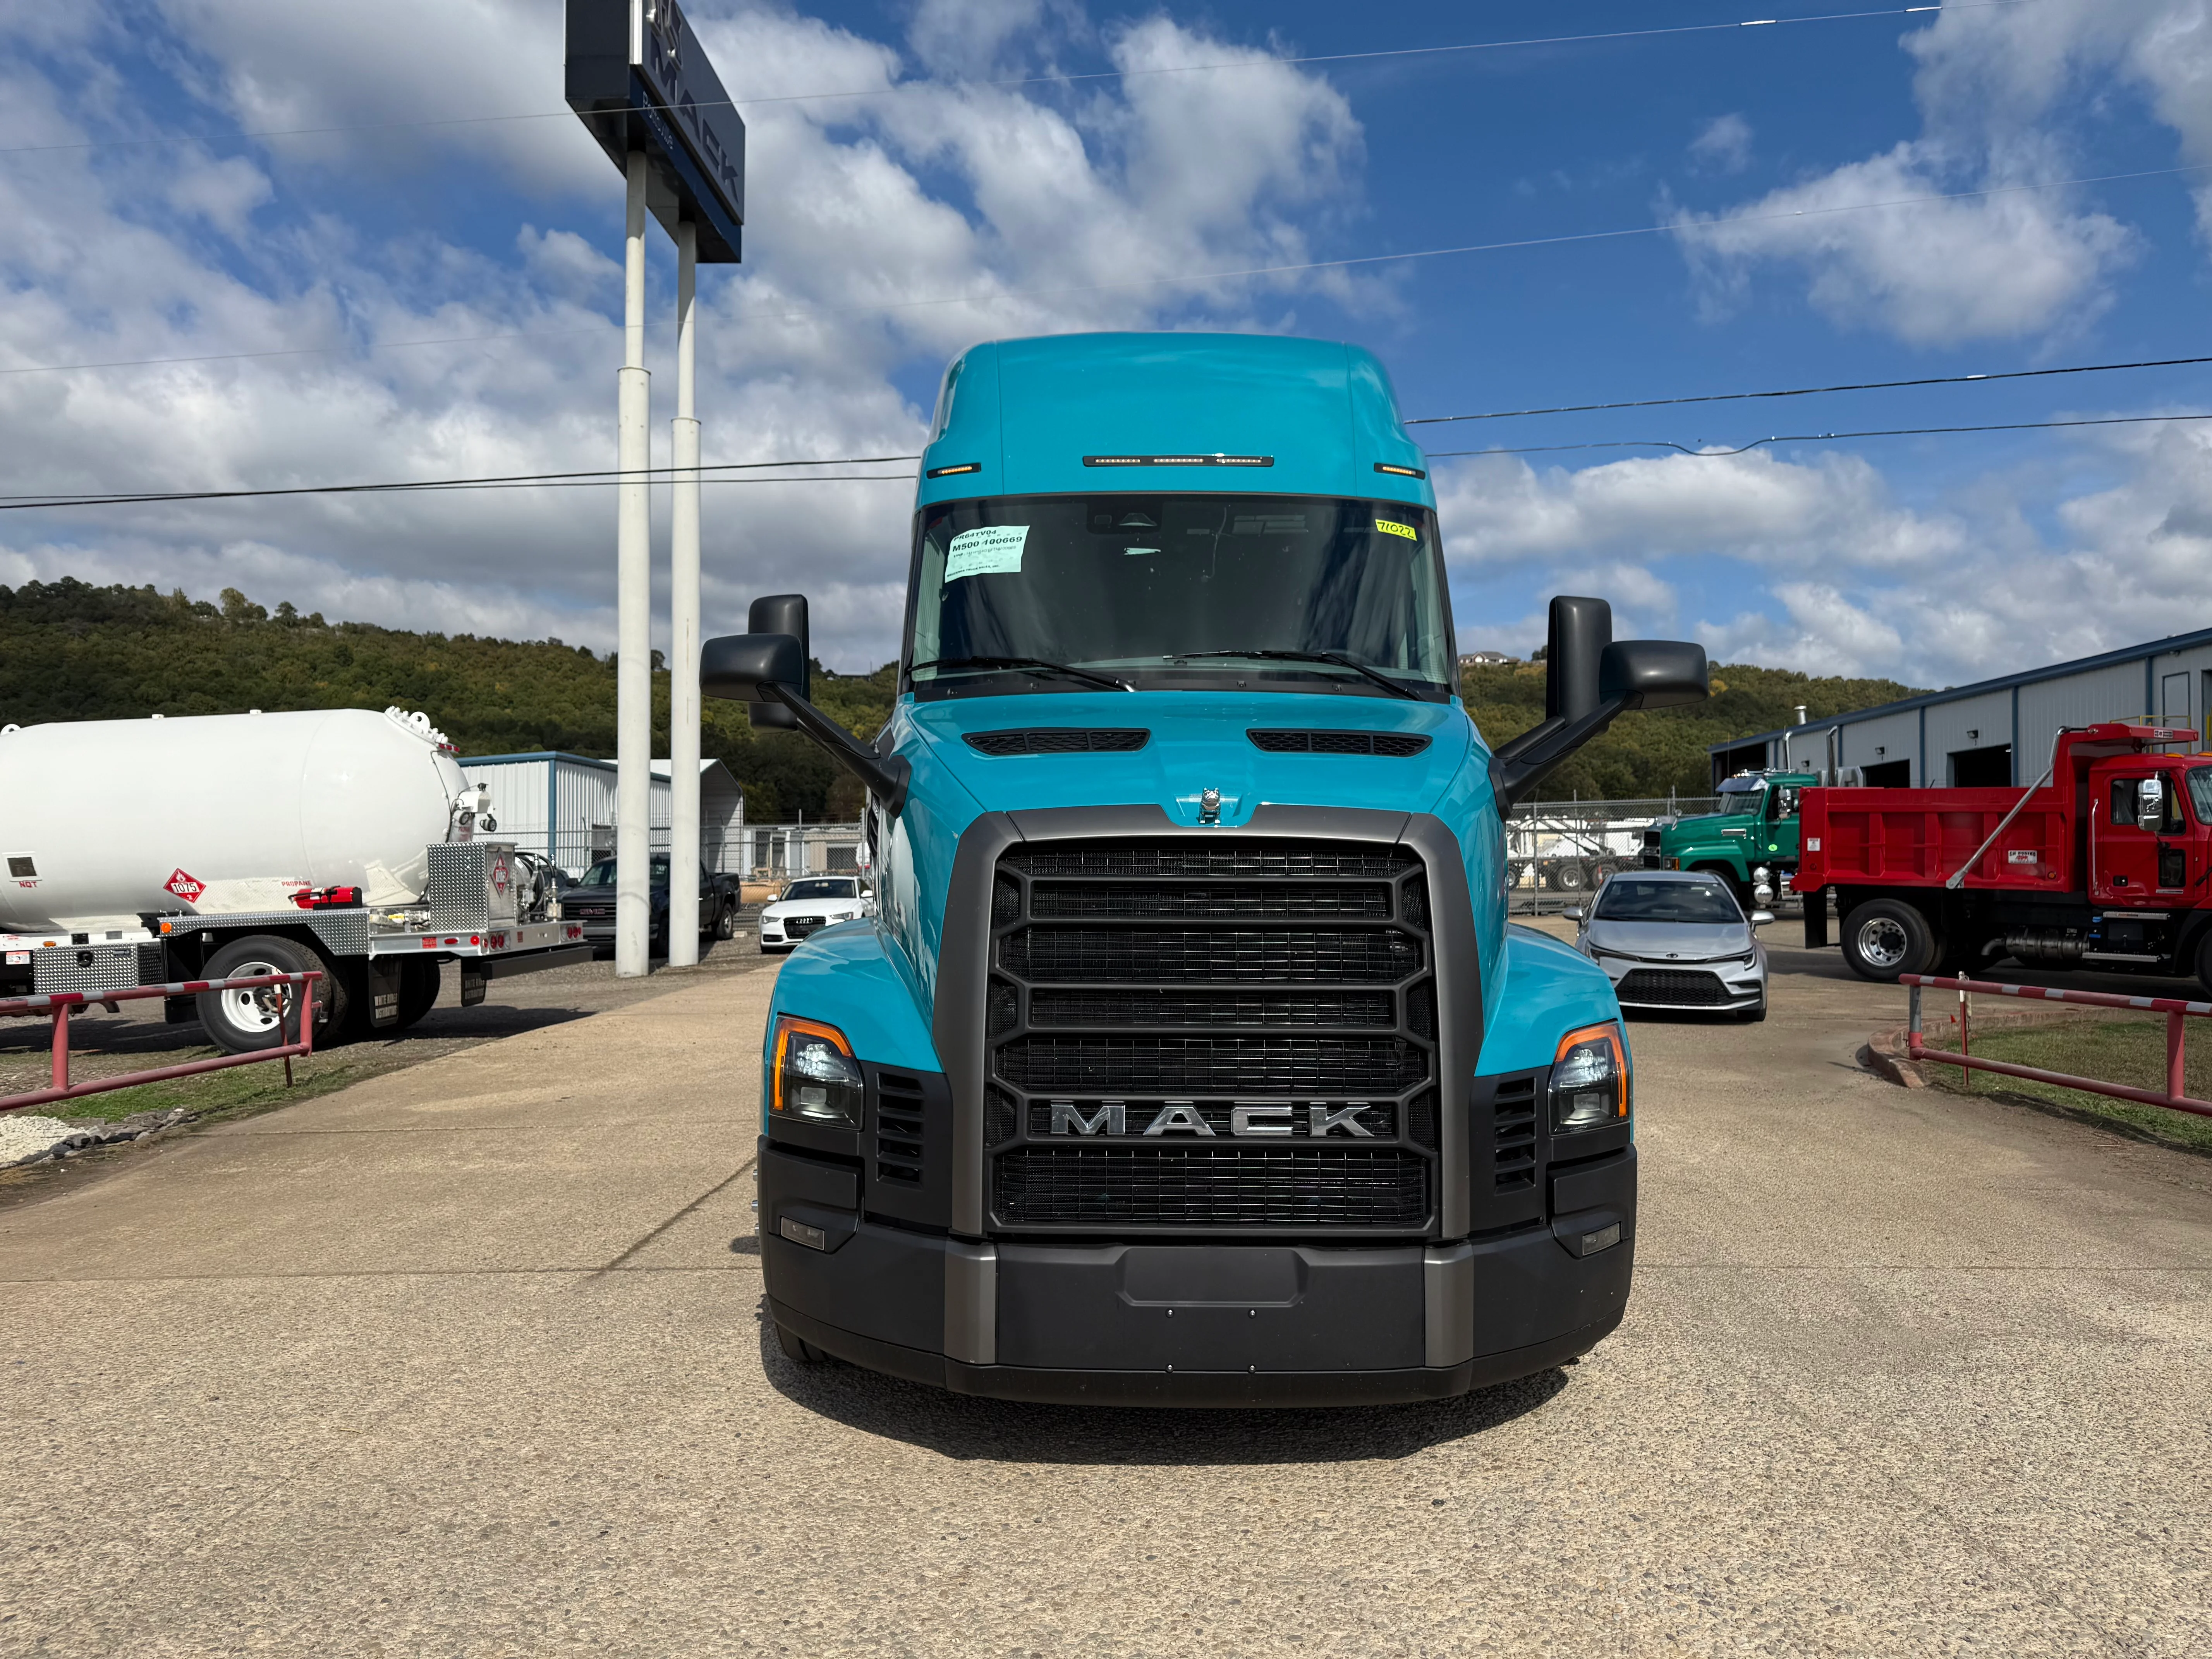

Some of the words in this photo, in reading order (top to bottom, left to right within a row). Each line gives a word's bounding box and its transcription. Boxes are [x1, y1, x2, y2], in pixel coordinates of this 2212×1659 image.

[651, 30, 738, 204] MACK
[954, 530, 996, 541] PR64TV04
[1377, 522, 1414, 538] 71022
[953, 541, 979, 552] M500
[173, 883, 197, 892] 1075
[1050, 1102, 1375, 1138] MACK
